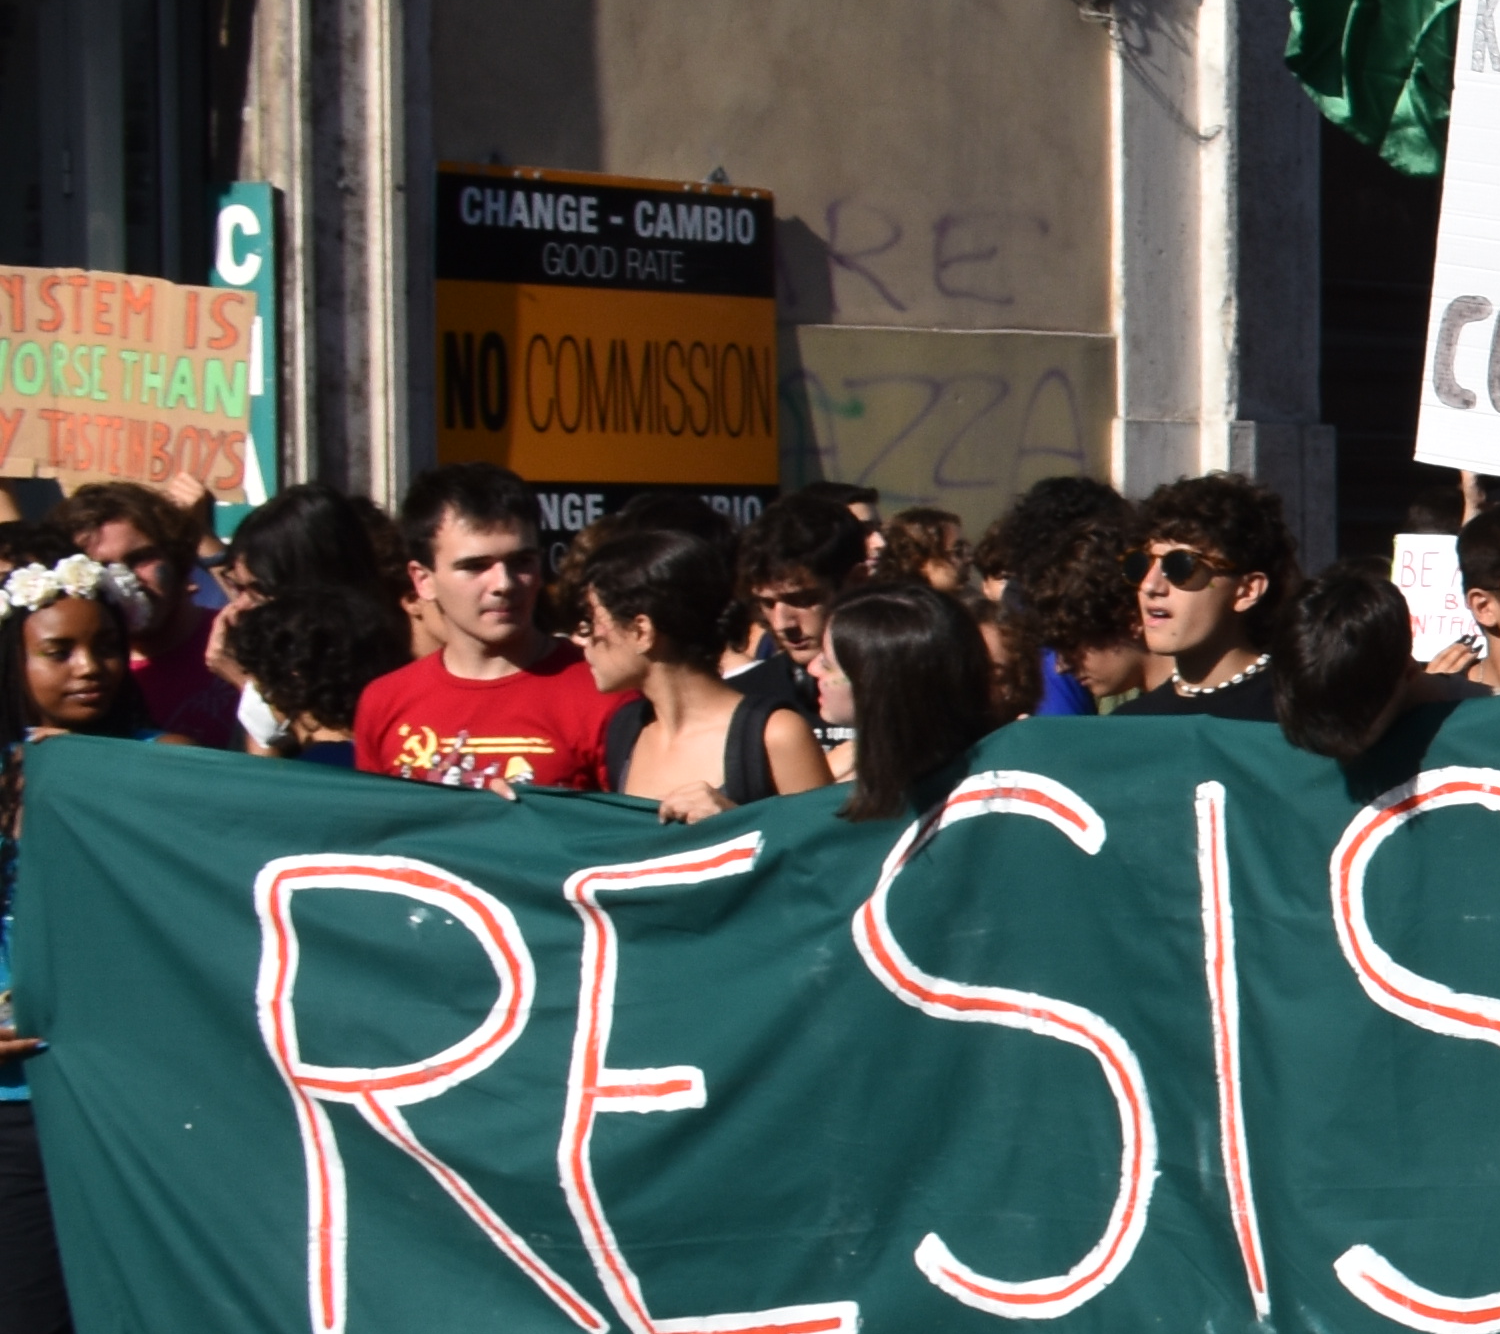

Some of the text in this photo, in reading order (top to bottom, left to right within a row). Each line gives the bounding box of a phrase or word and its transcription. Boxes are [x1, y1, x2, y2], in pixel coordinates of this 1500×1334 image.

[460, 186, 599, 234] CHANGE
[634, 200, 756, 245] CAMBIO
[542, 242, 685, 284] GOOD RATE
[0, 275, 245, 351] YSTEM IS
[119, 349, 247, 419] THAN
[444, 331, 772, 438] NO COMMISSION
[1400, 550, 1440, 588] BE
